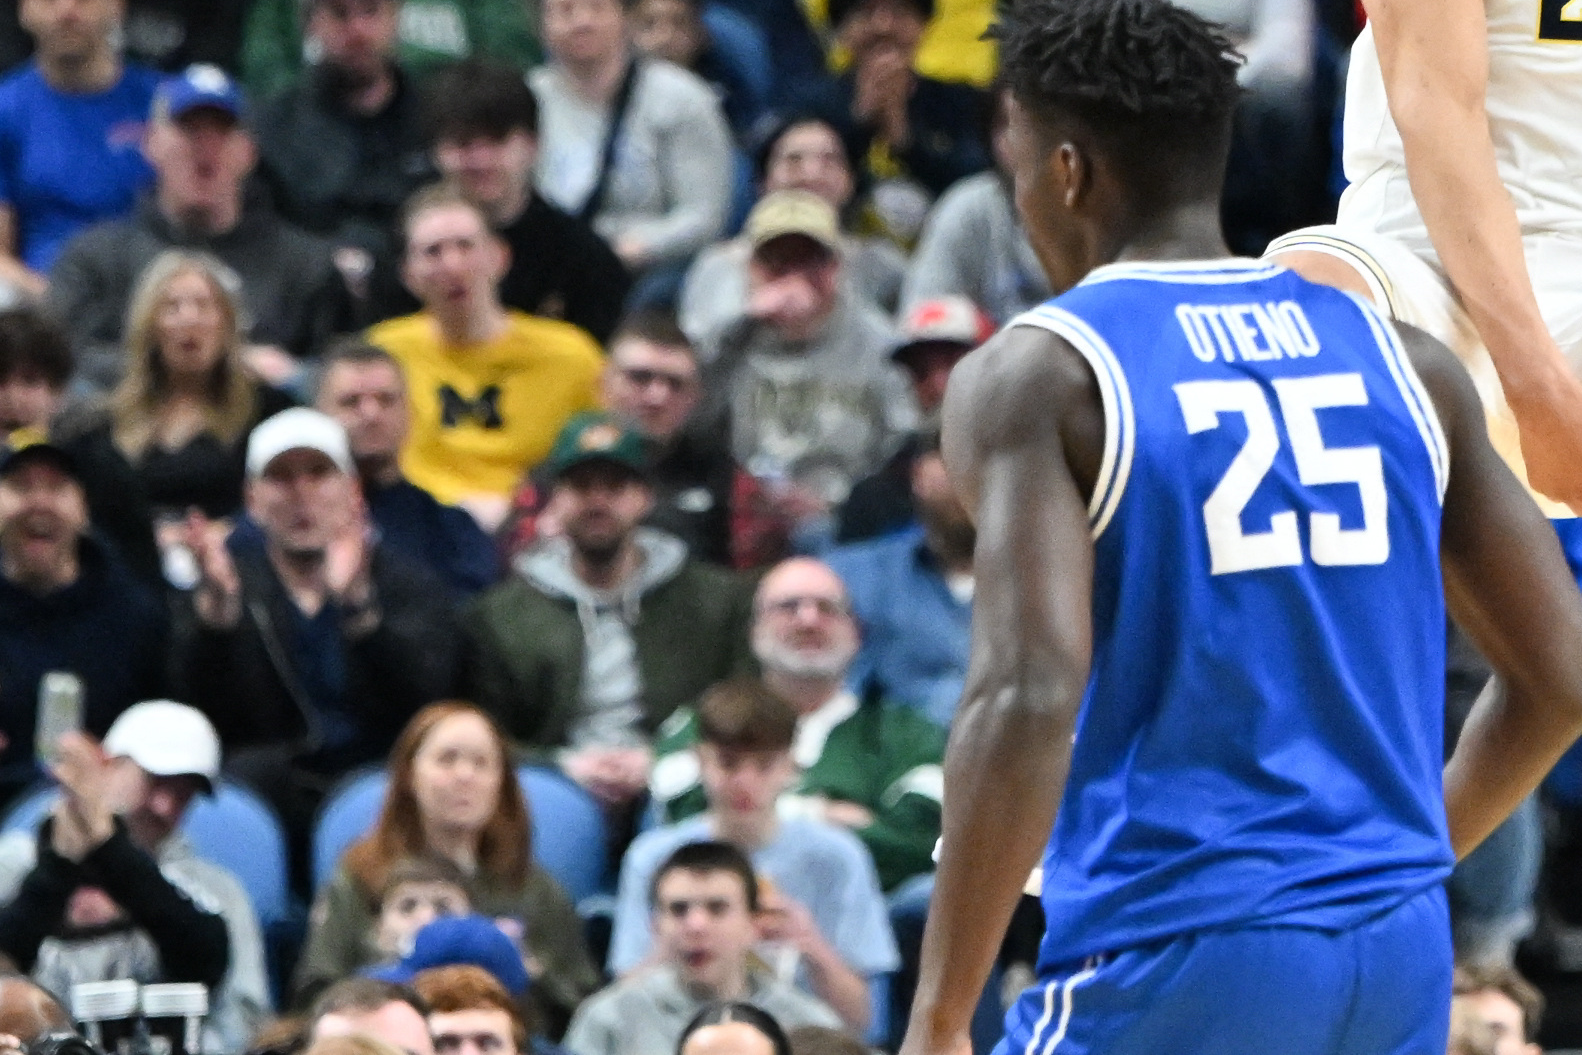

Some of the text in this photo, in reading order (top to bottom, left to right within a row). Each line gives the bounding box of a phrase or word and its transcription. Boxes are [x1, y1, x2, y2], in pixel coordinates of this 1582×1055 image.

[1175, 300, 1320, 363] OTIENO
[438, 382, 504, 430] M
[1172, 372, 1390, 576] 25
